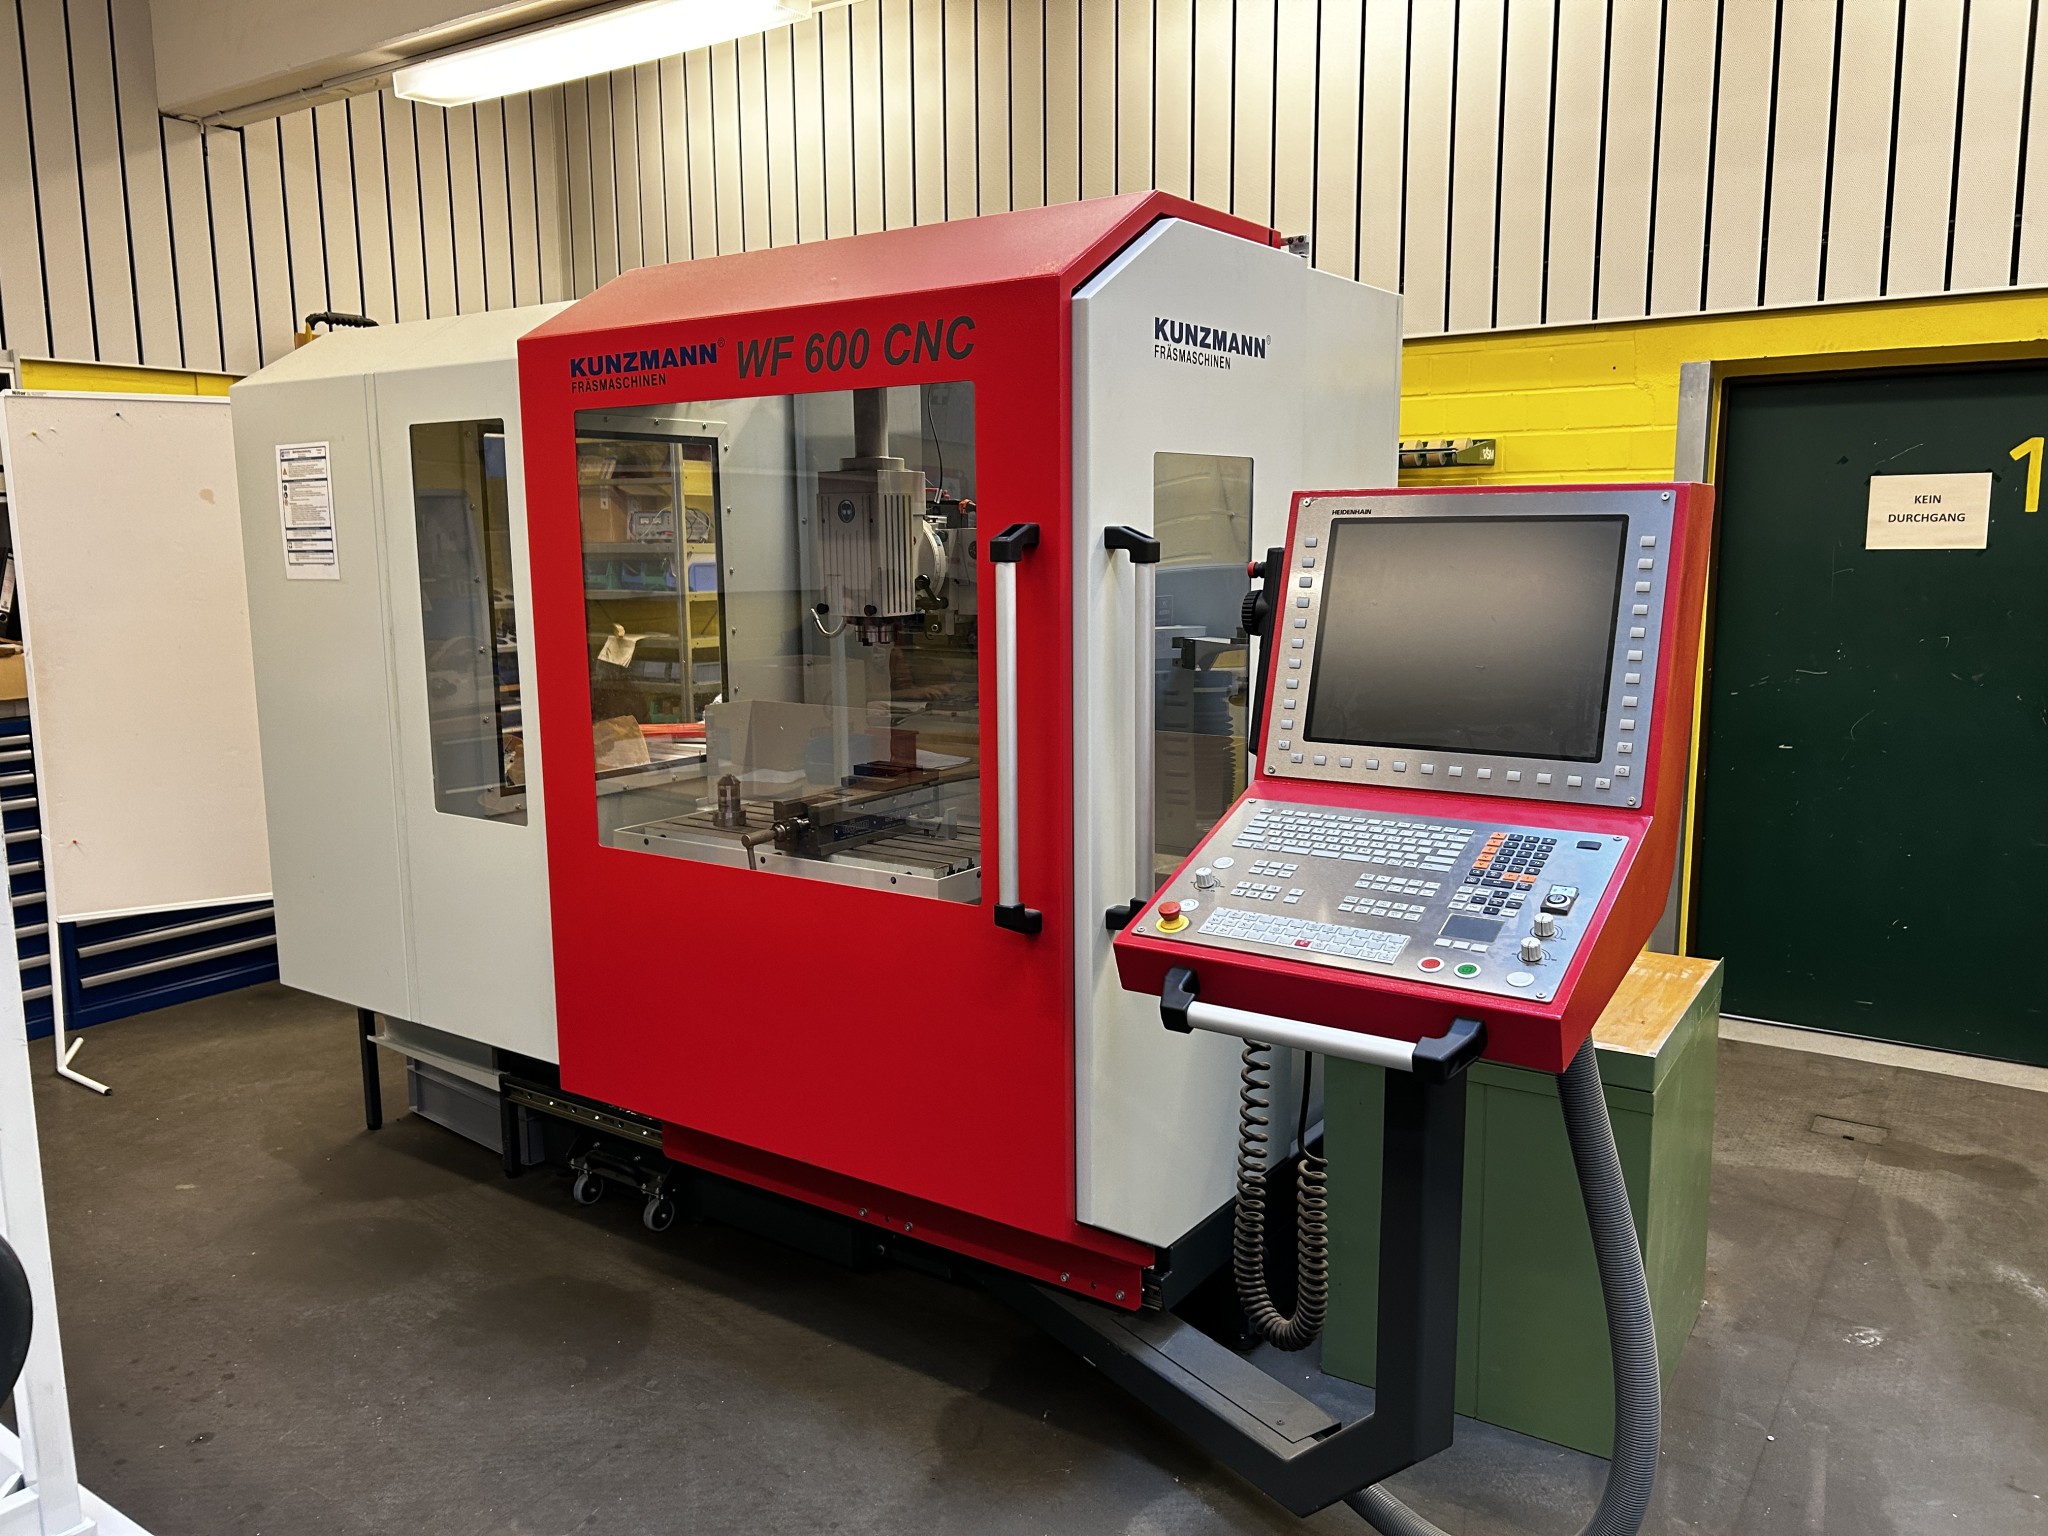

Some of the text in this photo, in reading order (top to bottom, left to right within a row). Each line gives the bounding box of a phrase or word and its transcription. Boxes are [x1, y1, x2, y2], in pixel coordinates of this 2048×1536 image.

[737, 335, 795, 379] WF
[804, 327, 870, 373] 600
[884, 315, 976, 366] CNC
[1154, 344, 1231, 370] FRÄSMASCHINEN
[571, 373, 666, 394] FRÄSMASCHINEN
[2009, 436, 2045, 513] 1
[1914, 494, 1942, 504] KEIN
[1888, 512, 1966, 523] DURCHGANG
